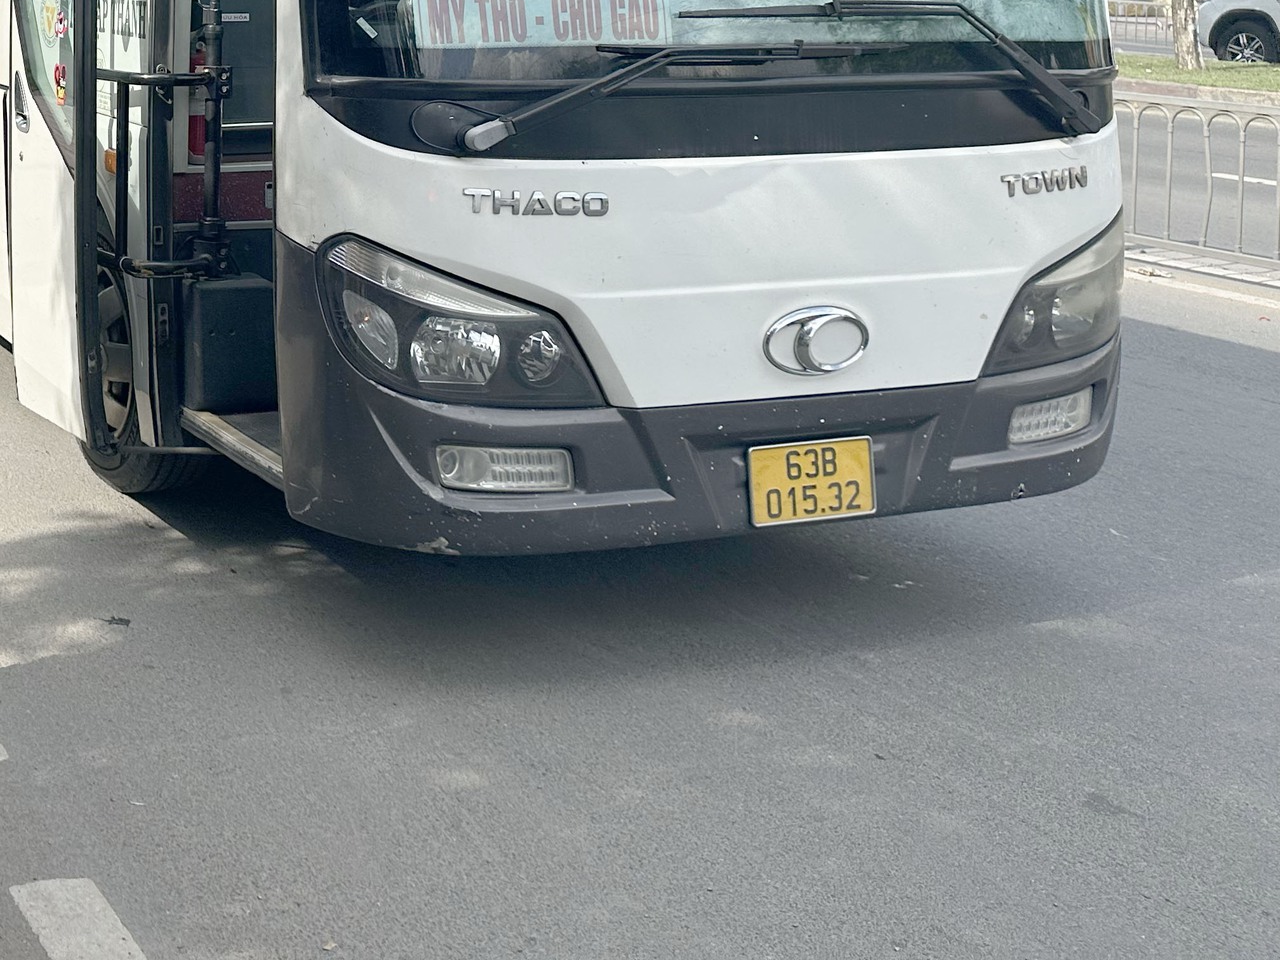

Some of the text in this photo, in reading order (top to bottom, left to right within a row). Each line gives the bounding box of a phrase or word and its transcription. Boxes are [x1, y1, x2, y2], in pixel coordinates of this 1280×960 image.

[1000, 165, 1087, 198] TOWN
[463, 188, 609, 217] THACO
[786, 447, 837, 480] 63B
[766, 480, 861, 518] 015.32
